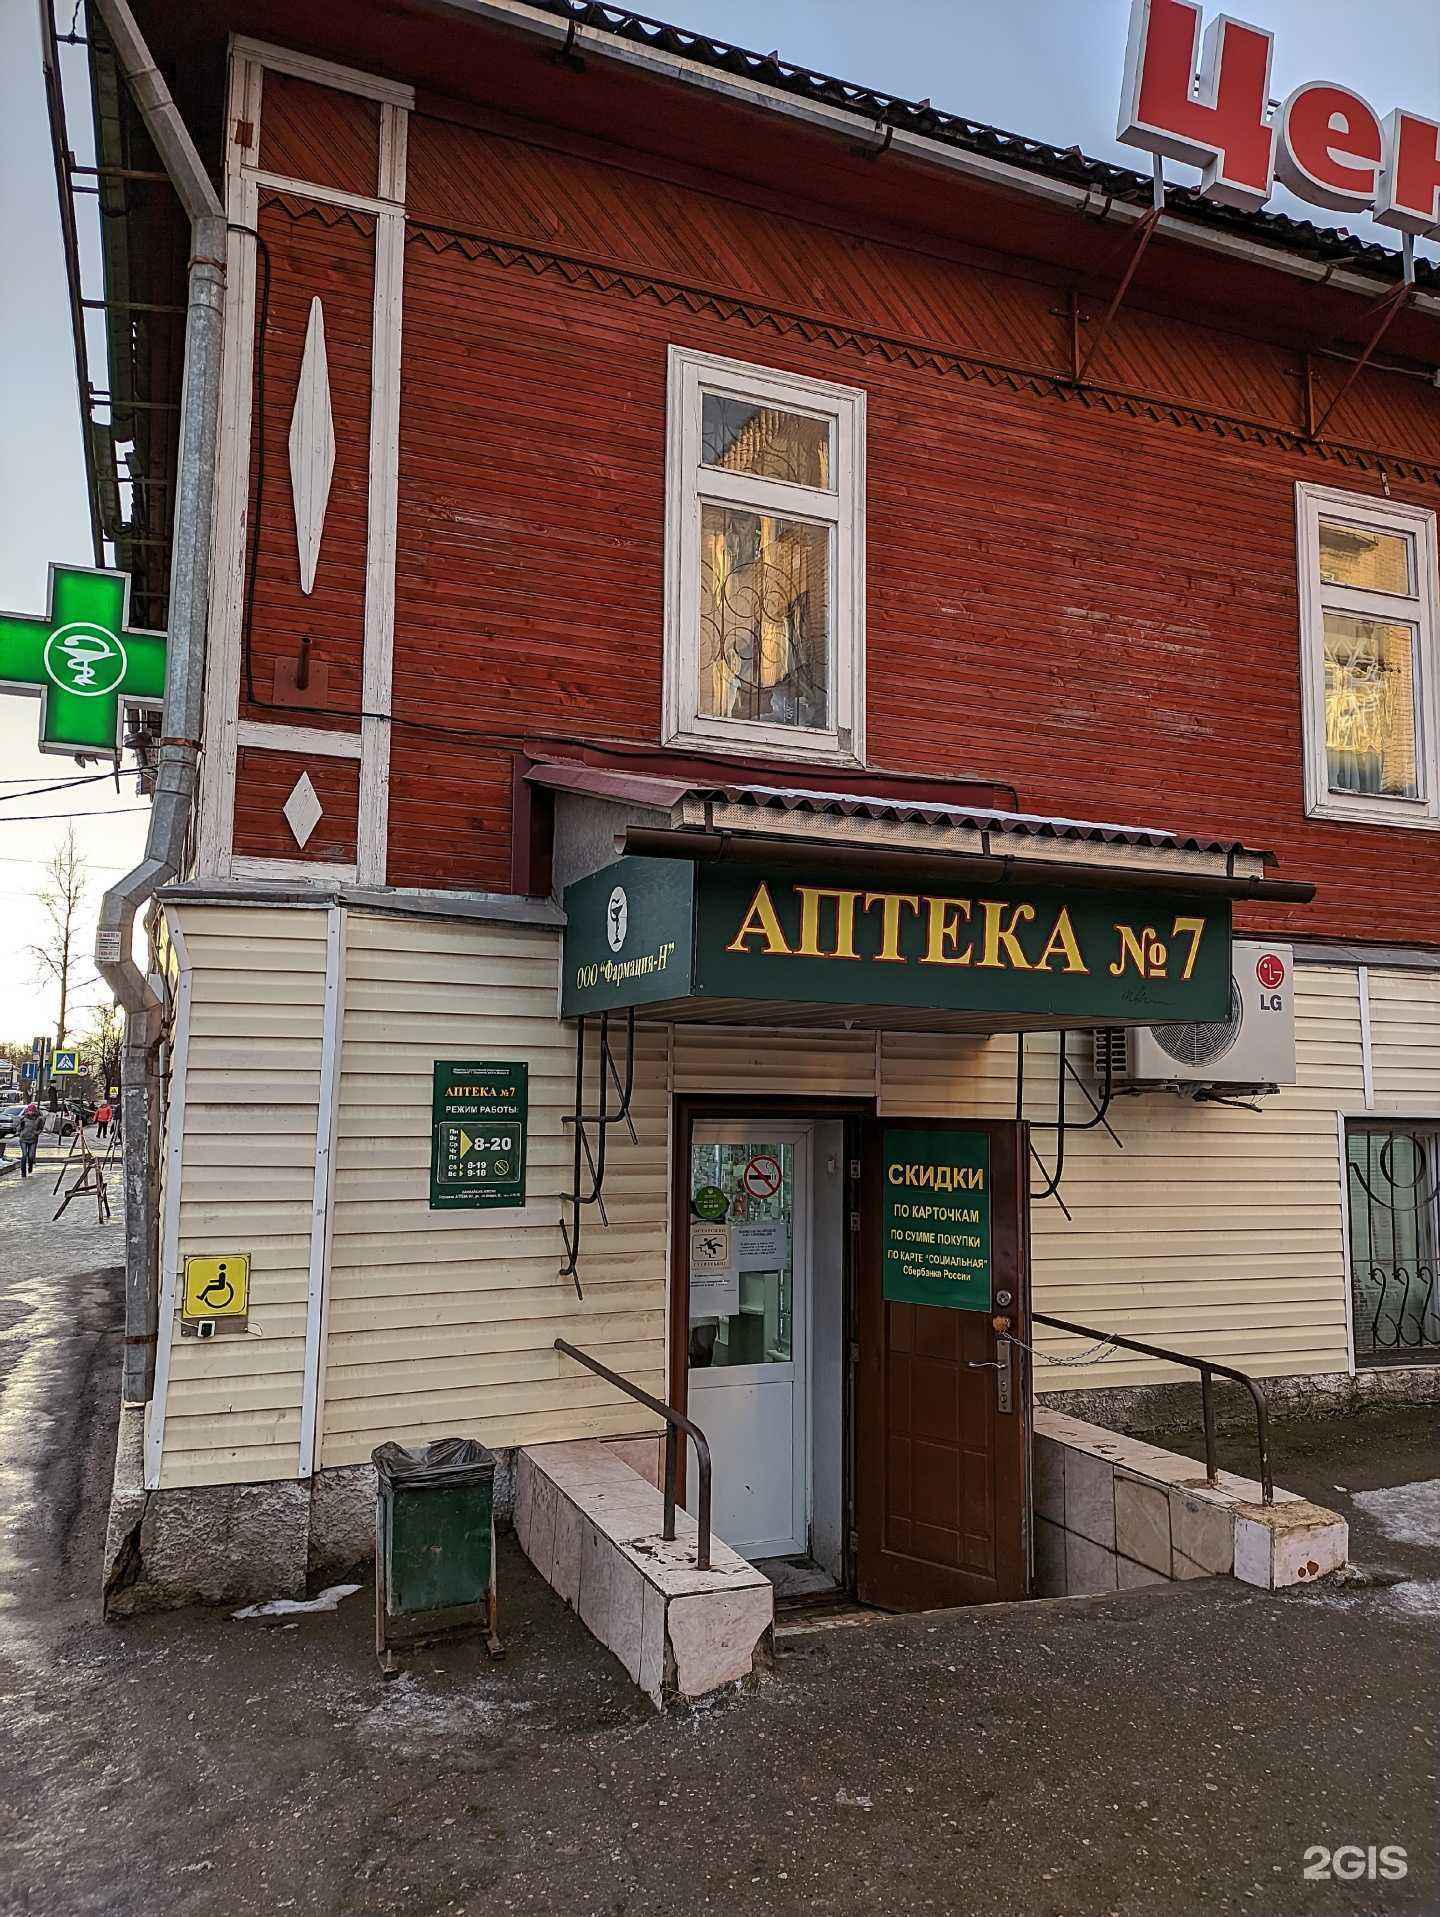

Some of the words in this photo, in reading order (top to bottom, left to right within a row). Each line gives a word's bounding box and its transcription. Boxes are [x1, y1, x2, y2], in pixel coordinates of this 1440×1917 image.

[725, 880, 1091, 975] АПТЕКА
[577, 963, 598, 989] ООО
[1260, 994, 1282, 1010] LG
[445, 1086, 497, 1097] АПТЕКА
[445, 1105, 478, 1113] РЕЖИМ
[480, 1106, 519, 1114] РАБОТЫ:
[474, 1137, 512, 1151] 8-20
[888, 1164, 984, 1192] СКИДКИ
[894, 1203, 910, 1218] ПО
[912, 1205, 979, 1223] КАРТОЧКАМ
[890, 1229, 904, 1241] ПО
[905, 1230, 936, 1244] СУММЕ
[937, 1233, 981, 1248] ПОКУПКИ
[887, 1249, 899, 1260] ПО
[900, 1251, 924, 1263] КАРТЕ
[903, 1265, 941, 1278] Сбербанка
[943, 1269, 971, 1281] России
